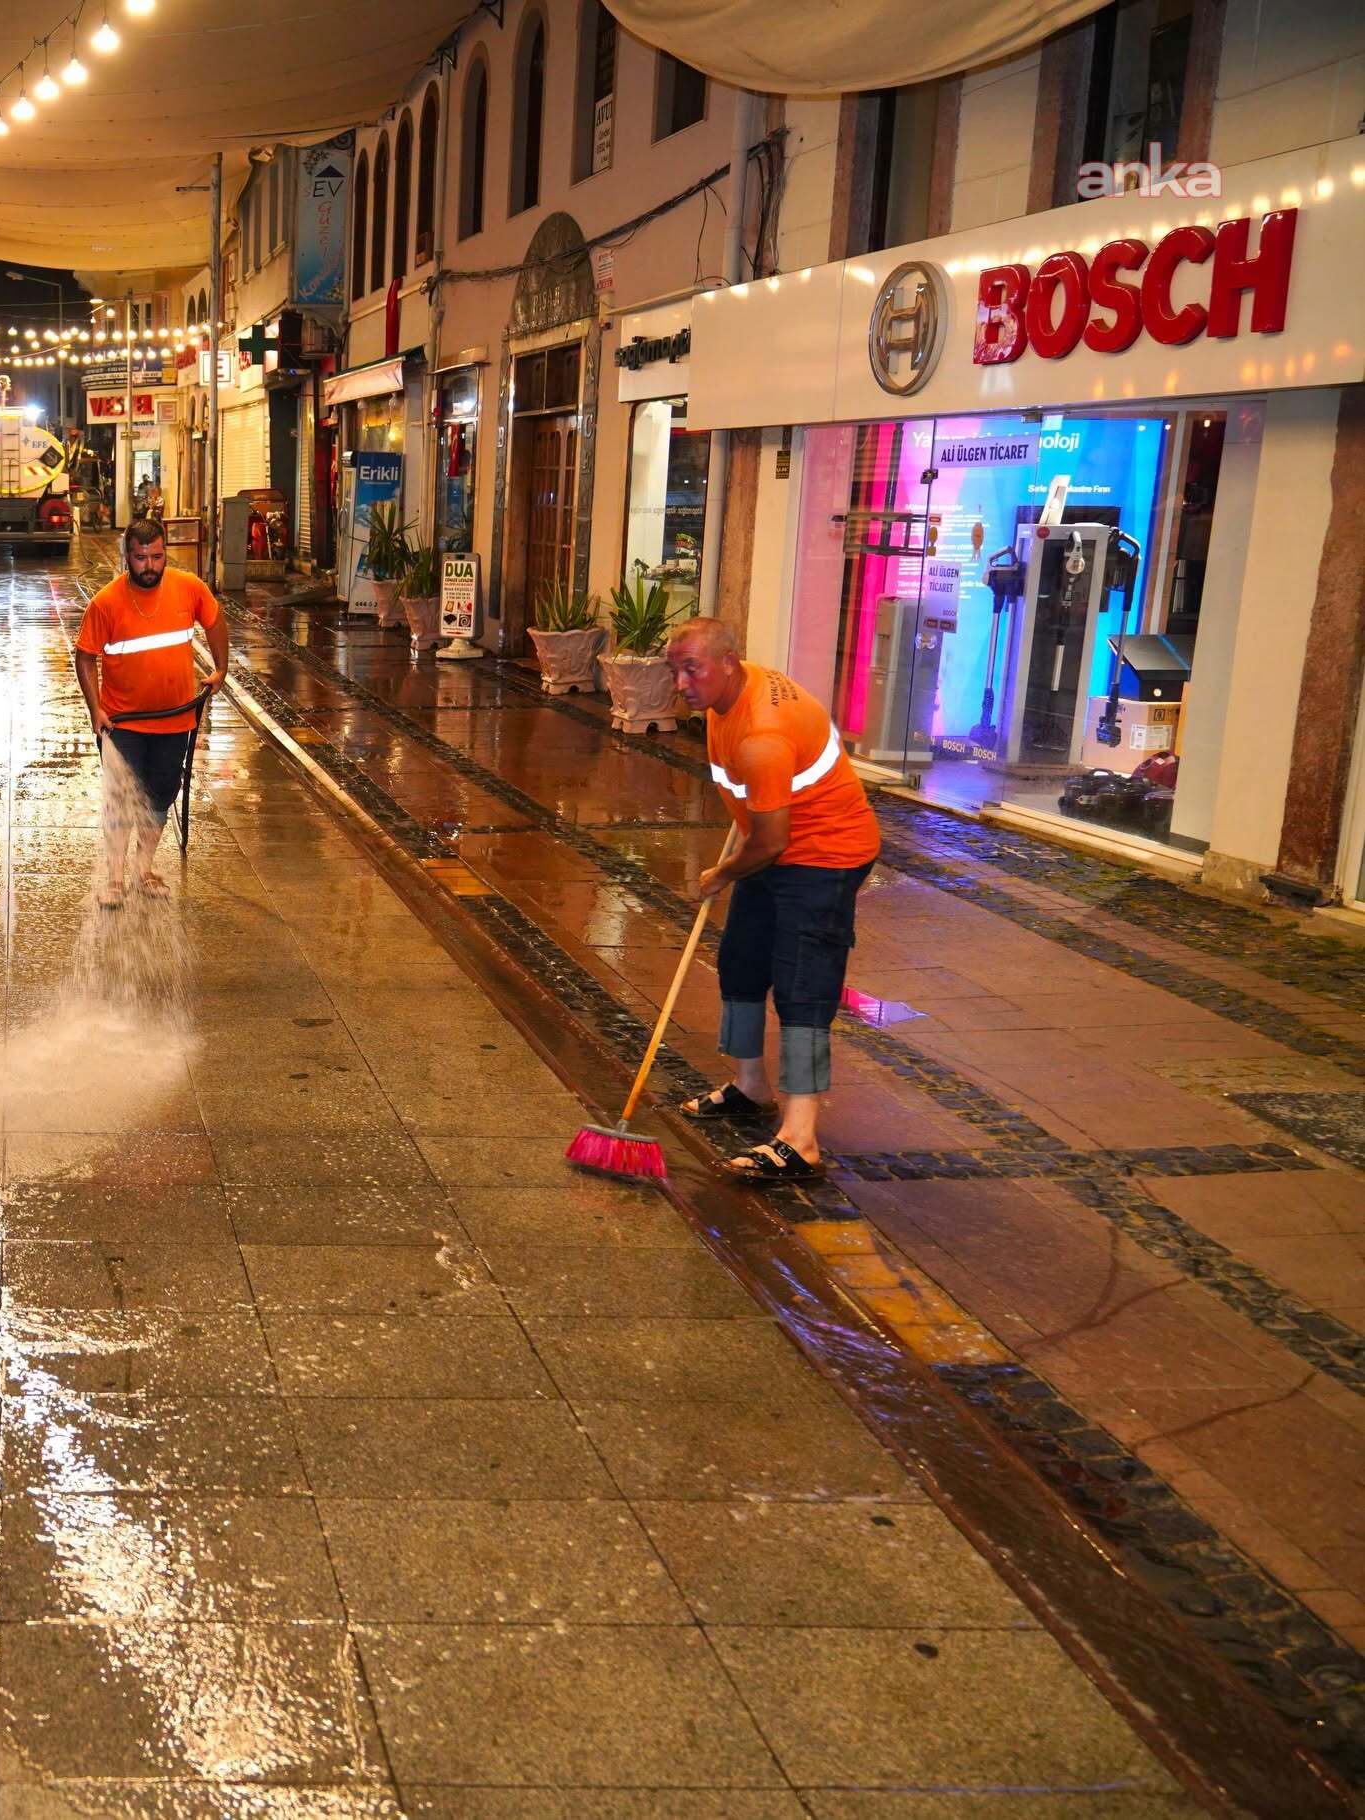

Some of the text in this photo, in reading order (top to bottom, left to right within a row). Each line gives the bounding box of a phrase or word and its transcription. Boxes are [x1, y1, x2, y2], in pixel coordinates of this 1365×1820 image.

[973, 208, 1298, 365] BOSCH
[90, 393, 155, 417] VESEL
[941, 442, 1029, 463] ALİ ÜLGEN TİCARET
[359, 465, 398, 481] Erikli
[445, 562, 474, 578] DUA
[928, 565, 959, 578] ALİ ÜLGEN
[929, 581, 954, 593] TİCARET
[942, 739, 965, 753] BOSCH
[972, 746, 997, 761] BOSCH
